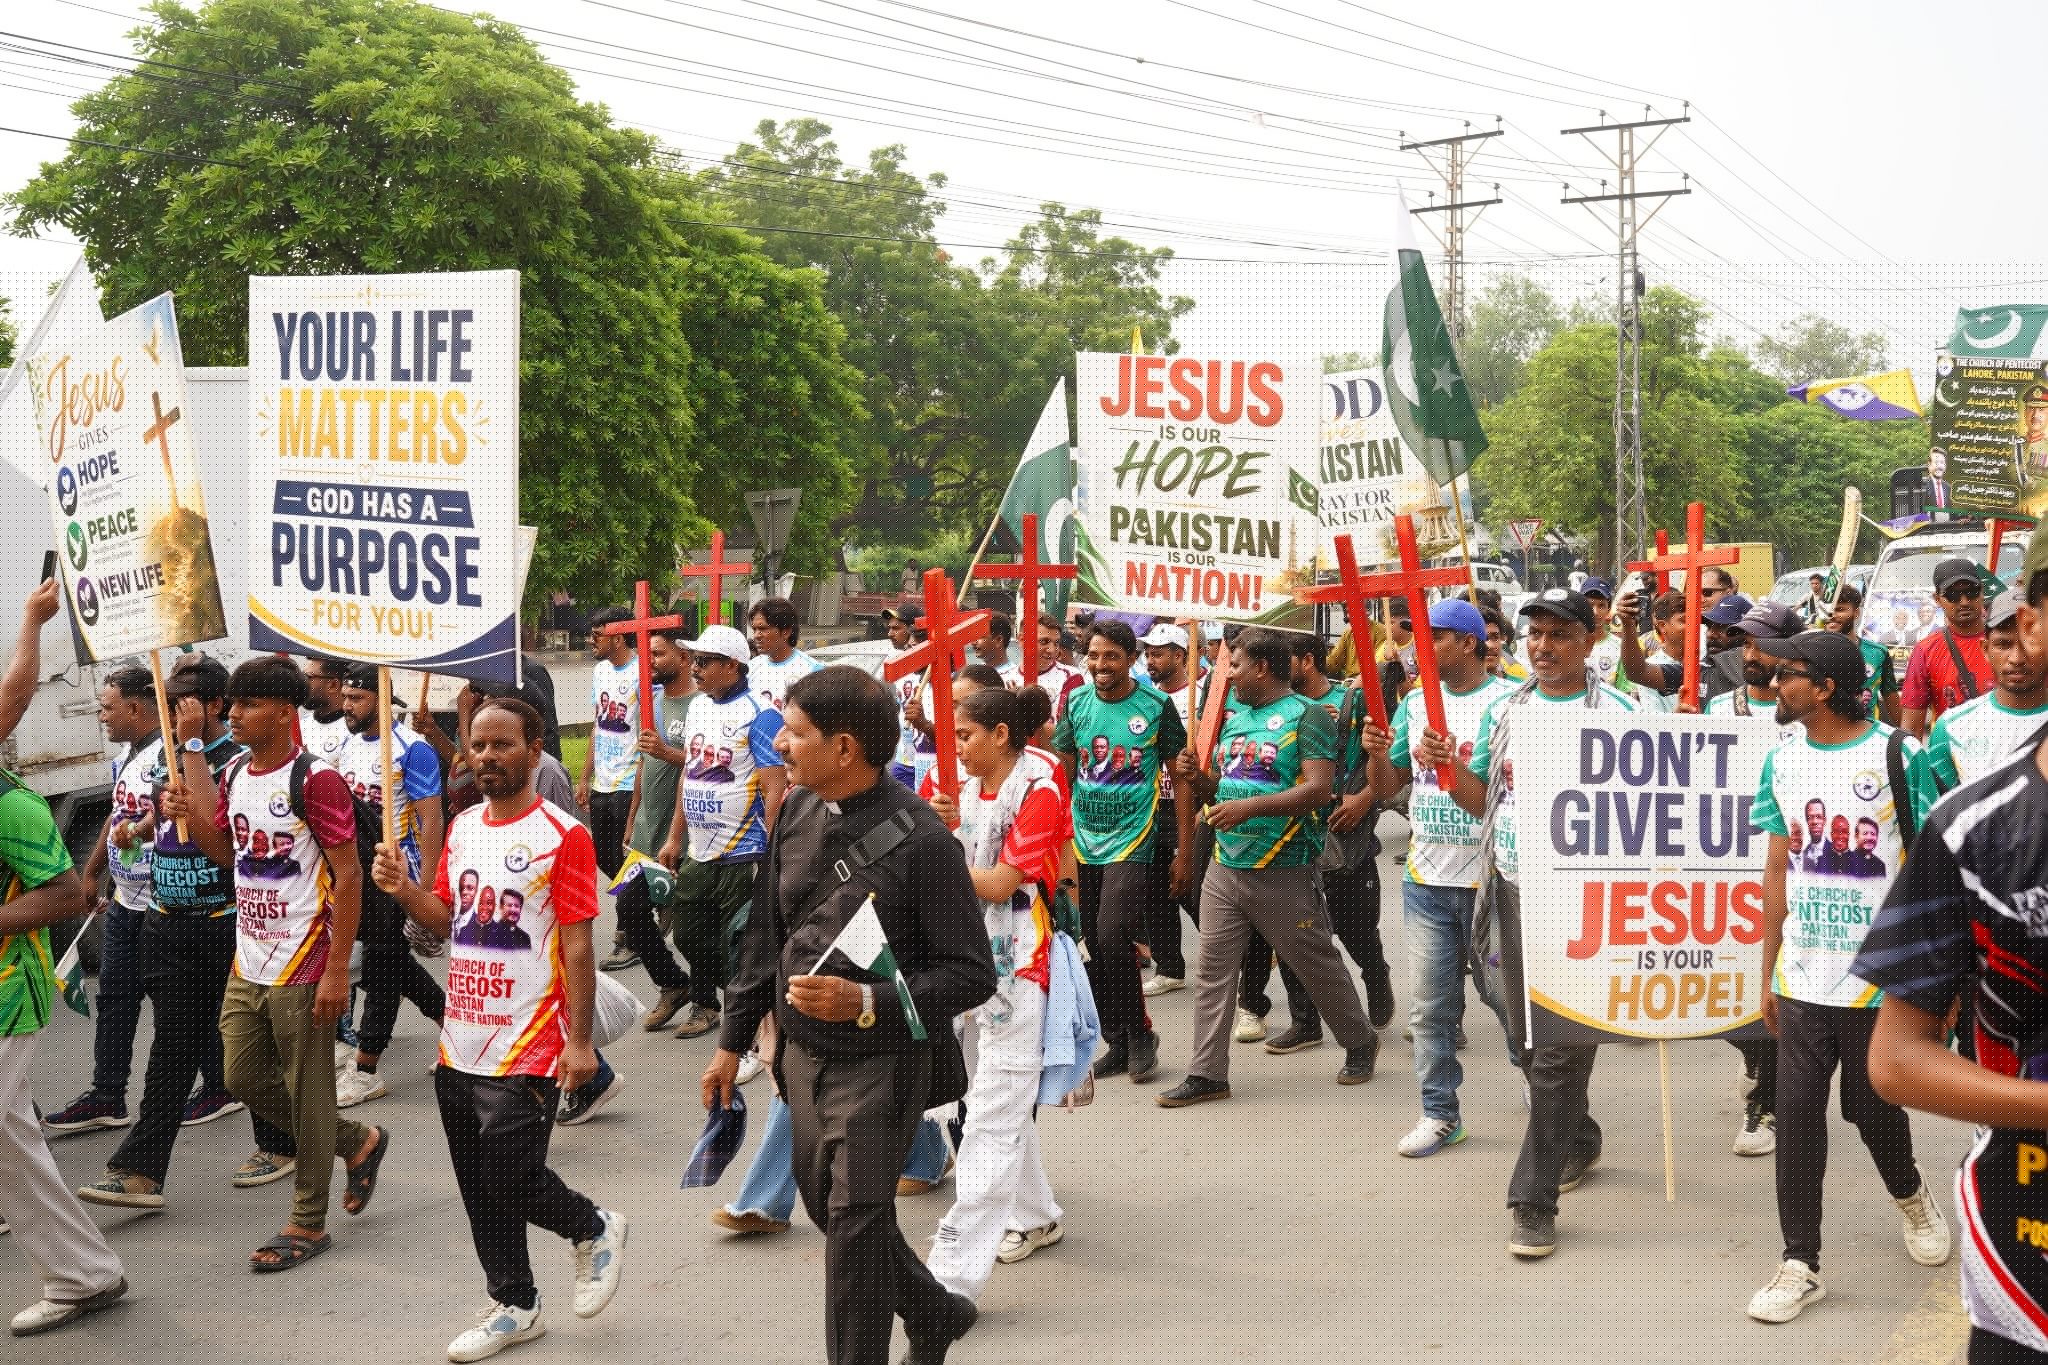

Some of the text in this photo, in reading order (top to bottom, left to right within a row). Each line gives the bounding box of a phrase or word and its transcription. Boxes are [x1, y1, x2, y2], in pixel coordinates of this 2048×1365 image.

[272, 309, 473, 382] YOUR LIFE
[1997, 370, 2034, 381] PAKISTAN
[1100, 355, 1284, 427] JESUS
[1321, 378, 1382, 423] OD
[47, 354, 128, 463] Jesus
[78, 426, 109, 450] GIVES
[279, 388, 468, 465] MATTERS
[1160, 425, 1221, 443] IS OUR
[77, 450, 120, 486] HOPE
[1113, 440, 1271, 499] HOPE
[1320, 437, 1404, 484] KISTAN
[306, 488, 438, 522] GOD HAS A
[1319, 488, 1392, 511] RAY FOR
[87, 507, 138, 544] PEACE
[1319, 505, 1397, 528] AKISTAN
[1110, 506, 1280, 559] PAKISTAN
[272, 522, 482, 608] PURPOSE
[1168, 551, 1215, 566] IS OUR
[98, 563, 166, 600] NEW LIFE
[1126, 561, 1262, 612] NATION!
[312, 599, 433, 640] FOR YOU!
[1580, 728, 1738, 788] DON'T
[683, 798, 724, 814] TECOST
[1428, 795, 1455, 807] CHUR
[1413, 807, 1483, 825] PENTECO
[1550, 789, 1765, 858] GIVE UP
[1424, 825, 1470, 837] PAKISTAN
[1446, 836, 1461, 846] THE
[1462, 837, 1481, 847] NATI
[158, 855, 207, 870] CHURCH OF
[127, 873, 151, 881] NATION
[152, 866, 219, 886] NTECOST
[266, 889, 279, 901] OF
[1809, 886, 1847, 902] CHRCH
[1851, 889, 1863, 903] OF
[238, 899, 289, 919] TECOST
[1566, 881, 1765, 960] JESUS
[1790, 900, 1872, 926] NTCOST
[1802, 922, 1848, 938] PAKSTAN
[1637, 950, 1713, 969] IS YOUR
[1841, 940, 1861, 953] NATI
[450, 958, 505, 977] CHURCH OF
[448, 973, 515, 999] NTECOST
[1607, 973, 1744, 1021] HOPE!
[463, 1010, 475, 1023] THE
[477, 1014, 513, 1026] NATIONS
[2017, 1143, 2048, 1185] P
[2016, 1217, 2048, 1250] POS
